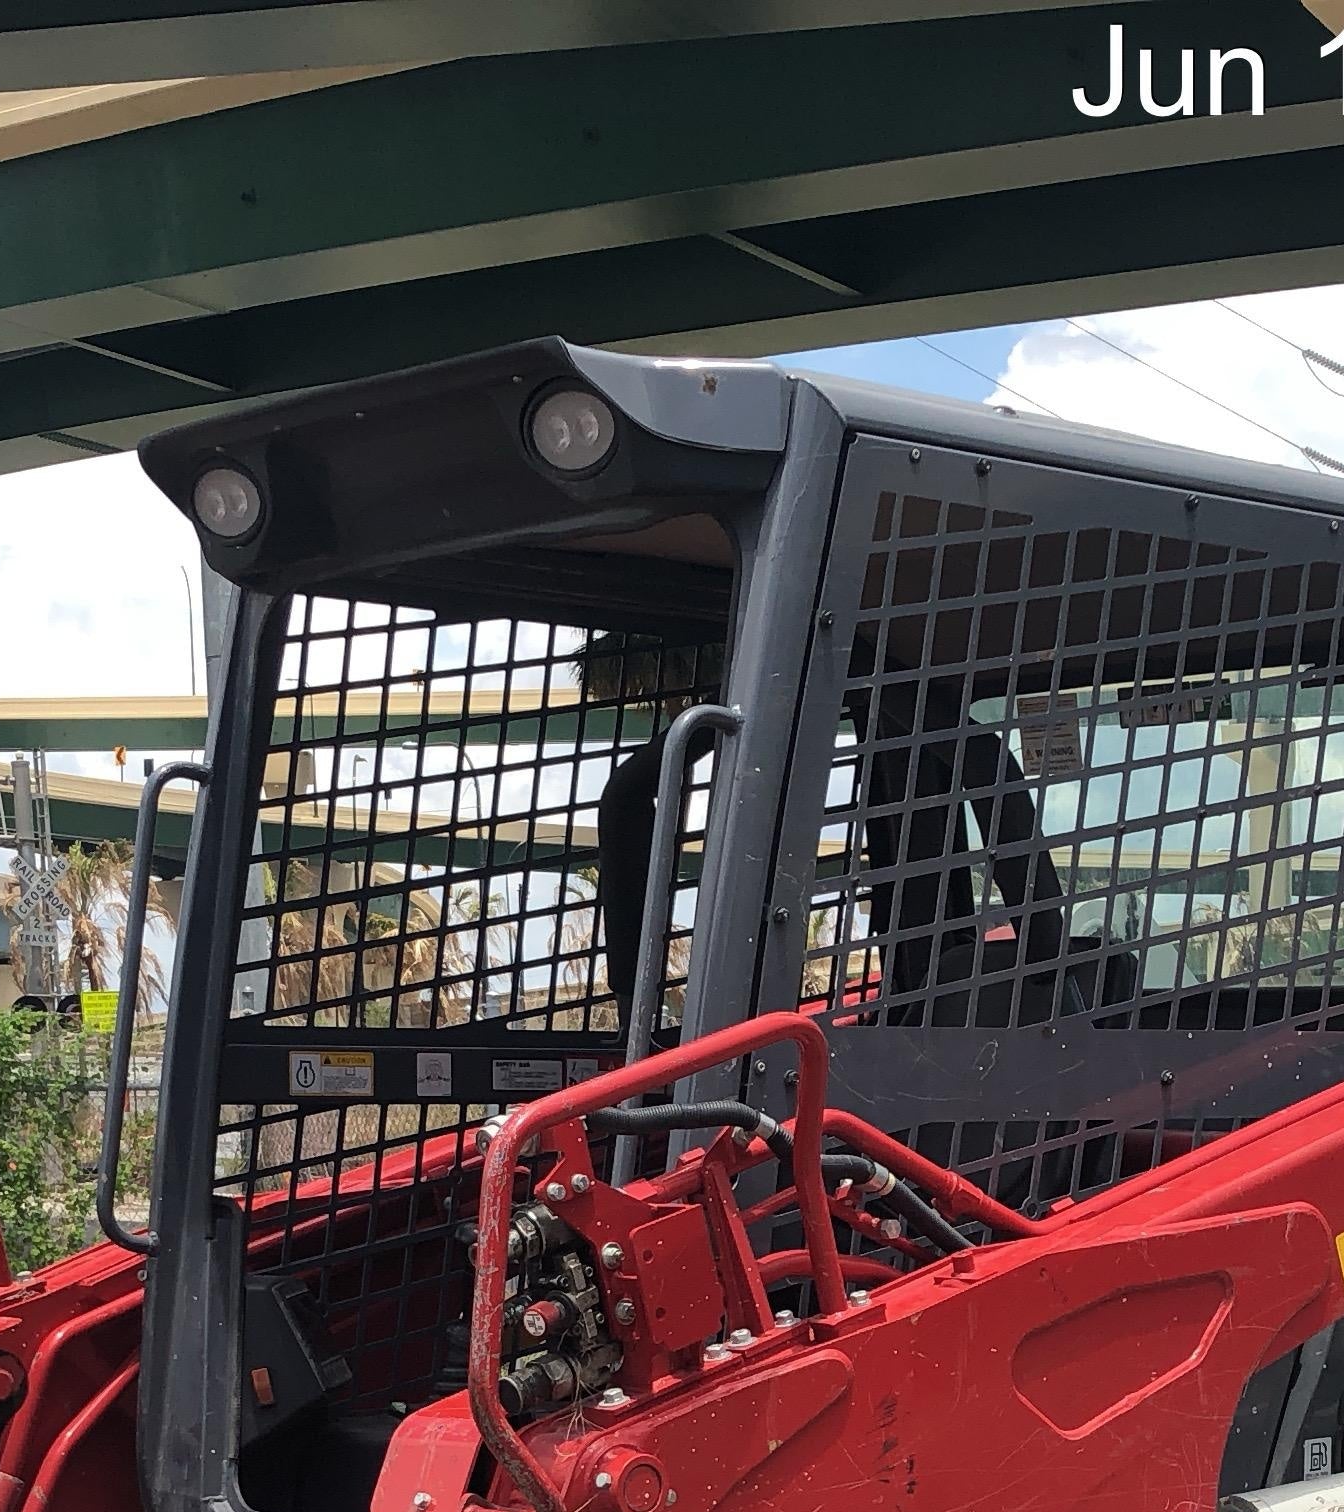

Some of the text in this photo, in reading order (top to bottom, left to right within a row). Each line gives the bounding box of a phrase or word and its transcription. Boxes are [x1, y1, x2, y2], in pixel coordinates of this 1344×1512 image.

[12, 857, 71, 917] RAIL ROAD
[18, 860, 66, 915] CROSSING
[19, 933, 56, 944] TRACKS
[33, 918, 41, 929] 2
